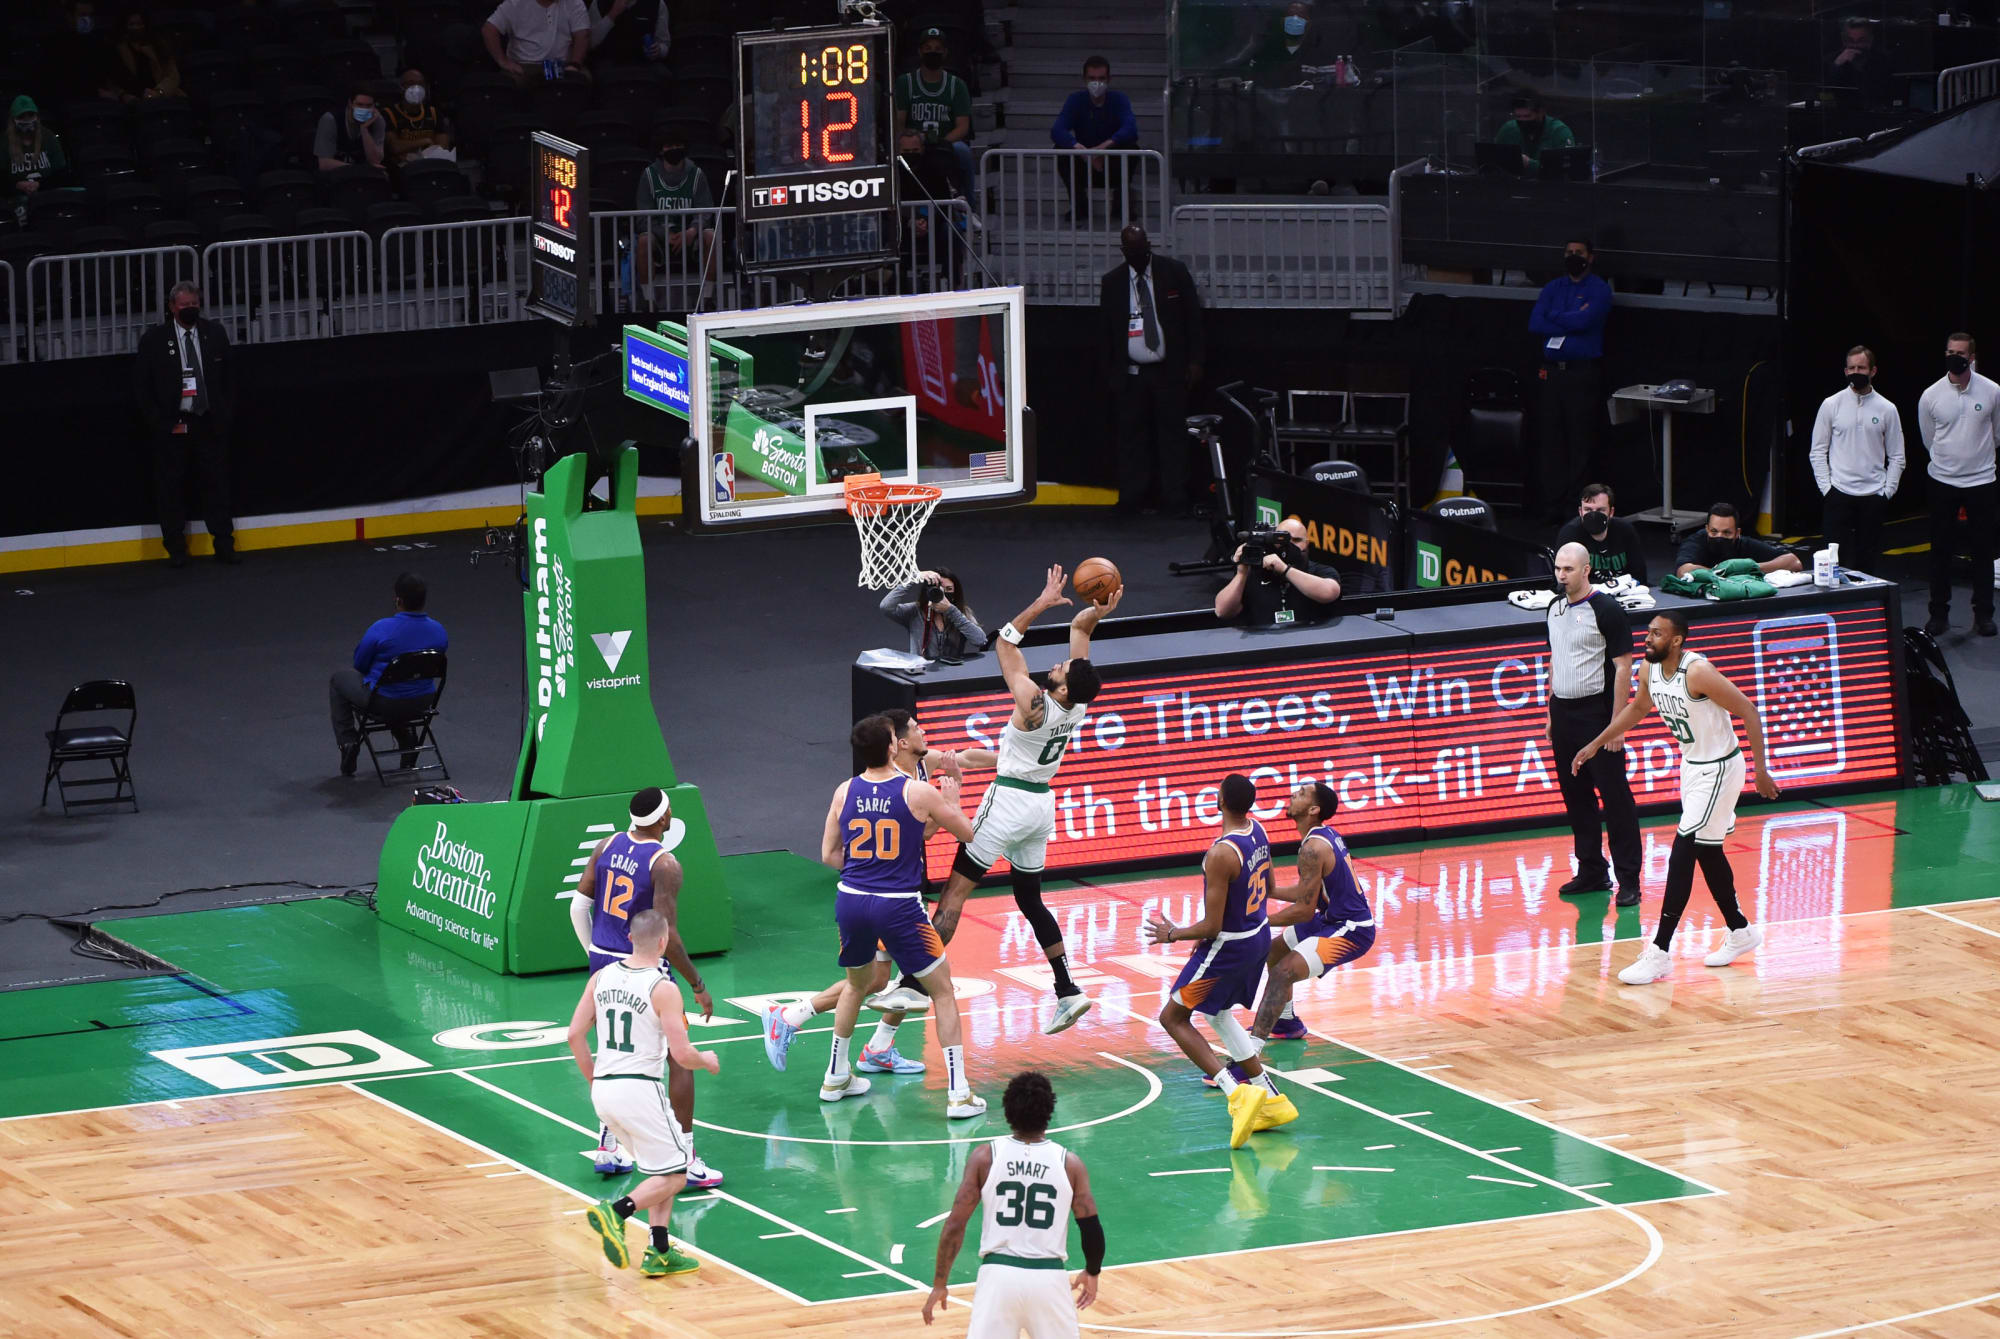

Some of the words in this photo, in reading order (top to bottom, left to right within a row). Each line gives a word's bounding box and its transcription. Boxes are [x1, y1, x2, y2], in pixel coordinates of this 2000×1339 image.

[801, 45, 868, 86] 1:08
[801, 92, 859, 163] 12
[789, 178, 886, 204] TISSOT
[545, 241, 576, 263] TISSOT
[631, 368, 644, 385] New
[643, 373, 664, 393] England
[768, 435, 807, 473] Sports
[761, 460, 798, 488] BOSTON
[1323, 469, 1358, 482] Putnam
[709, 509, 742, 520] SPALDING
[1447, 505, 1485, 518] Putnam
[1286, 514, 1388, 568] ARDEN
[1419, 549, 1440, 582] TD
[553, 552, 568, 654] Sports
[564, 576, 574, 668] BOSTON
[586, 674, 641, 690] vistaprint
[1143, 691, 1350, 745] Threes,
[1365, 667, 1472, 722] Win
[1652, 693, 1689, 719] CELTICS
[1050, 721, 1077, 738] TATUM
[1037, 734, 1069, 766] 0
[1133, 777, 1224, 832] the
[430, 821, 484, 878] Boston
[848, 818, 901, 861] 20
[412, 844, 497, 920] Scientific
[610, 853, 639, 876] CRAIG
[603, 869, 635, 921] 12
[1245, 861, 1270, 917] 25
[405, 900, 443, 932] Advancing
[445, 918, 469, 940] science
[471, 928, 482, 945] for
[597, 988, 649, 1015] PRITCHARD
[606, 1008, 635, 1053] 11
[1007, 1160, 1050, 1180] SMART
[996, 1181, 1058, 1230] 36
